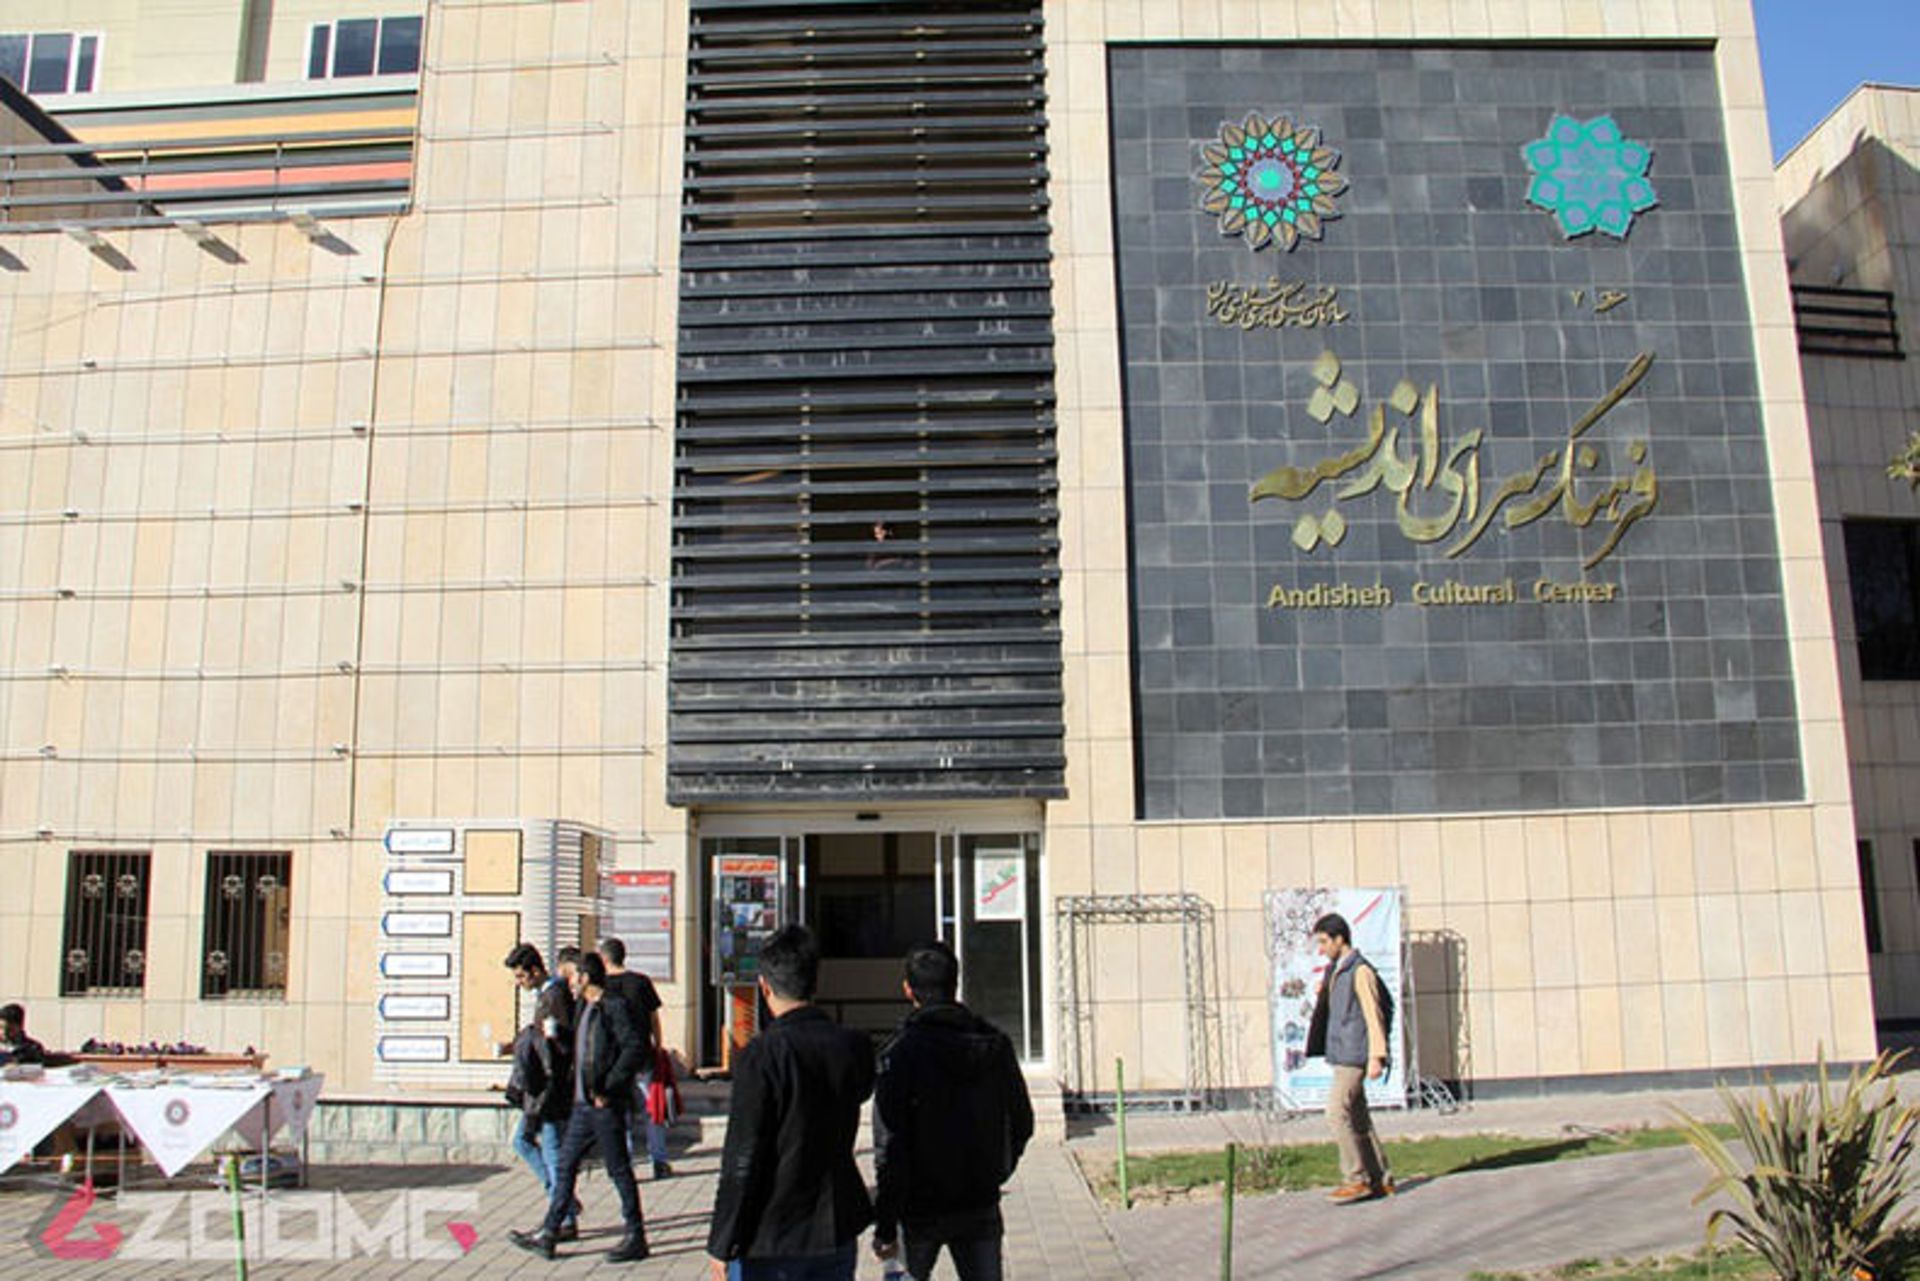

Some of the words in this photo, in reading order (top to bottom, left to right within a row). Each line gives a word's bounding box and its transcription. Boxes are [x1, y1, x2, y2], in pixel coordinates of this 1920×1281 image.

[1249, 349, 1440, 553] اندیشه
[1267, 583, 1394, 609] Andisheh
[1411, 580, 1517, 606] Cultural
[1533, 578, 1620, 602] Center
